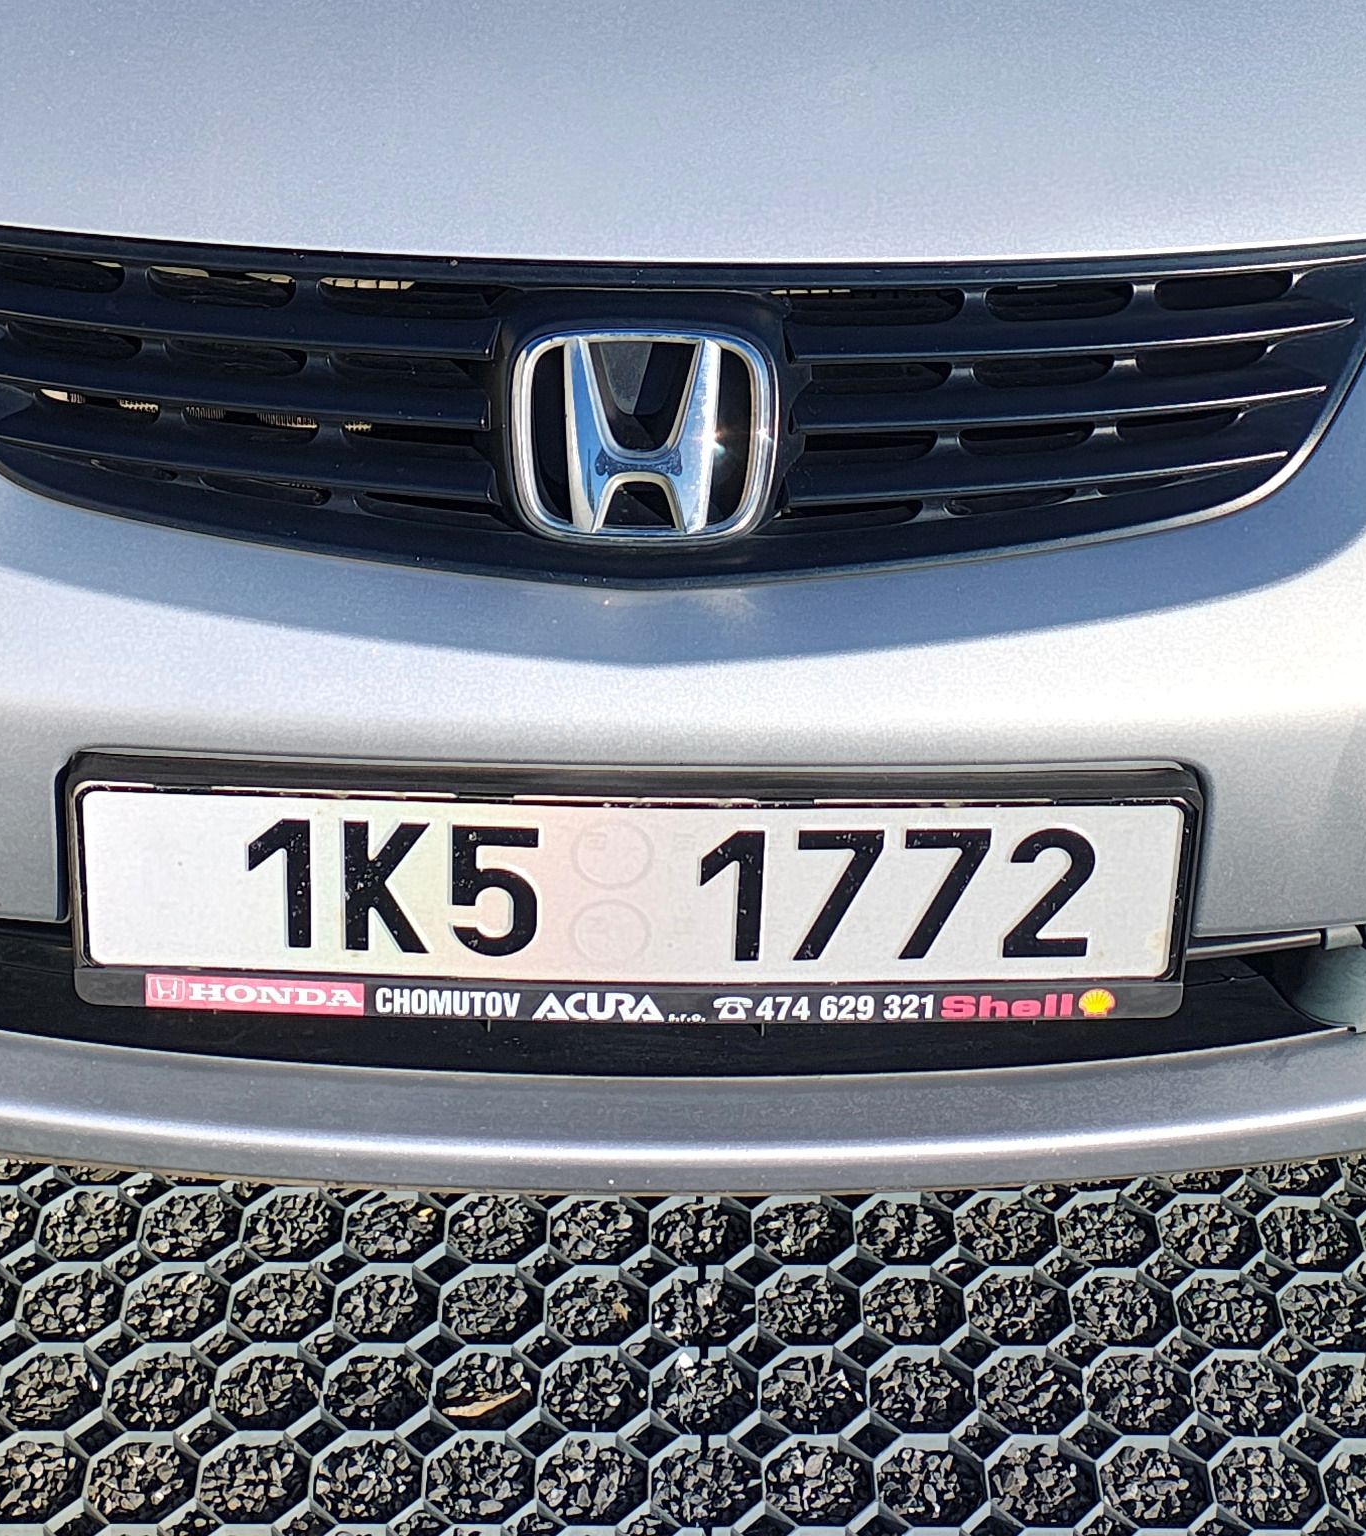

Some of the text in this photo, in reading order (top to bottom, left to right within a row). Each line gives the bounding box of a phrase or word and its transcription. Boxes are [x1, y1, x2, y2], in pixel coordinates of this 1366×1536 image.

[247, 818, 1096, 962] 1K5 1772
[188, 981, 363, 1007] HONDA
[375, 987, 521, 1018] CHOMUTOV
[531, 992, 665, 1022] ACURA
[755, 996, 811, 1021] 474
[819, 995, 875, 1021] 629
[883, 994, 935, 1020] 321
[940, 993, 1075, 1020] Shell
